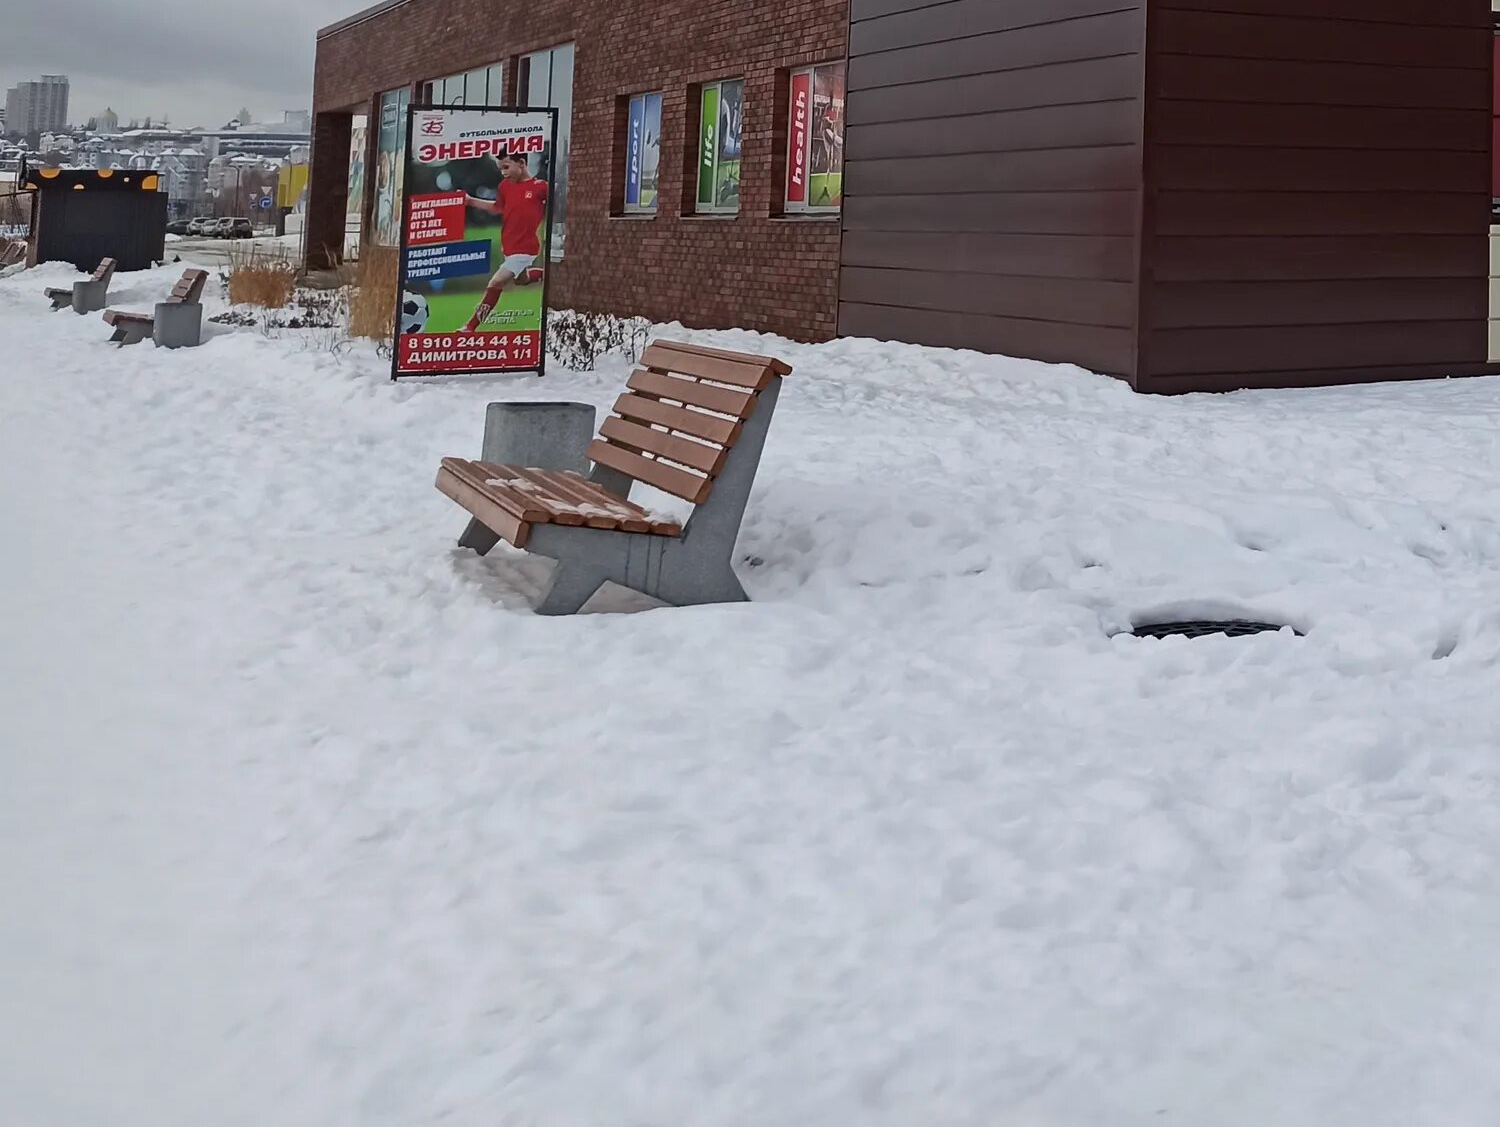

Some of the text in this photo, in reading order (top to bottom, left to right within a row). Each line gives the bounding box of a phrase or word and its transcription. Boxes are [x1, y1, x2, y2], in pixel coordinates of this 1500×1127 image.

[459, 126, 544, 138] ФУТБОЛЬНАЯ ШКОЛА
[792, 91, 805, 185] health
[419, 135, 543, 162] ЭНЕРГИЯ
[631, 119, 640, 185] sport
[704, 124, 713, 168] life
[411, 197, 464, 210] ПРИГЛАШАЕМ
[410, 209, 435, 220] ДЕТЕЙ
[410, 219, 442, 229] ОТ 3 ЛЕТ
[416, 228, 447, 238] СТАРШЕ
[408, 247, 447, 258] РАБОТАЮТ
[408, 251, 486, 268] ПРОФЕССИОНАЛЬНЫЕ
[407, 267, 440, 277] ТРЕНЕРЫ
[408, 335, 532, 348] 8 910 244 44 45
[407, 349, 532, 364] ДИМИТРОВА 1/1
